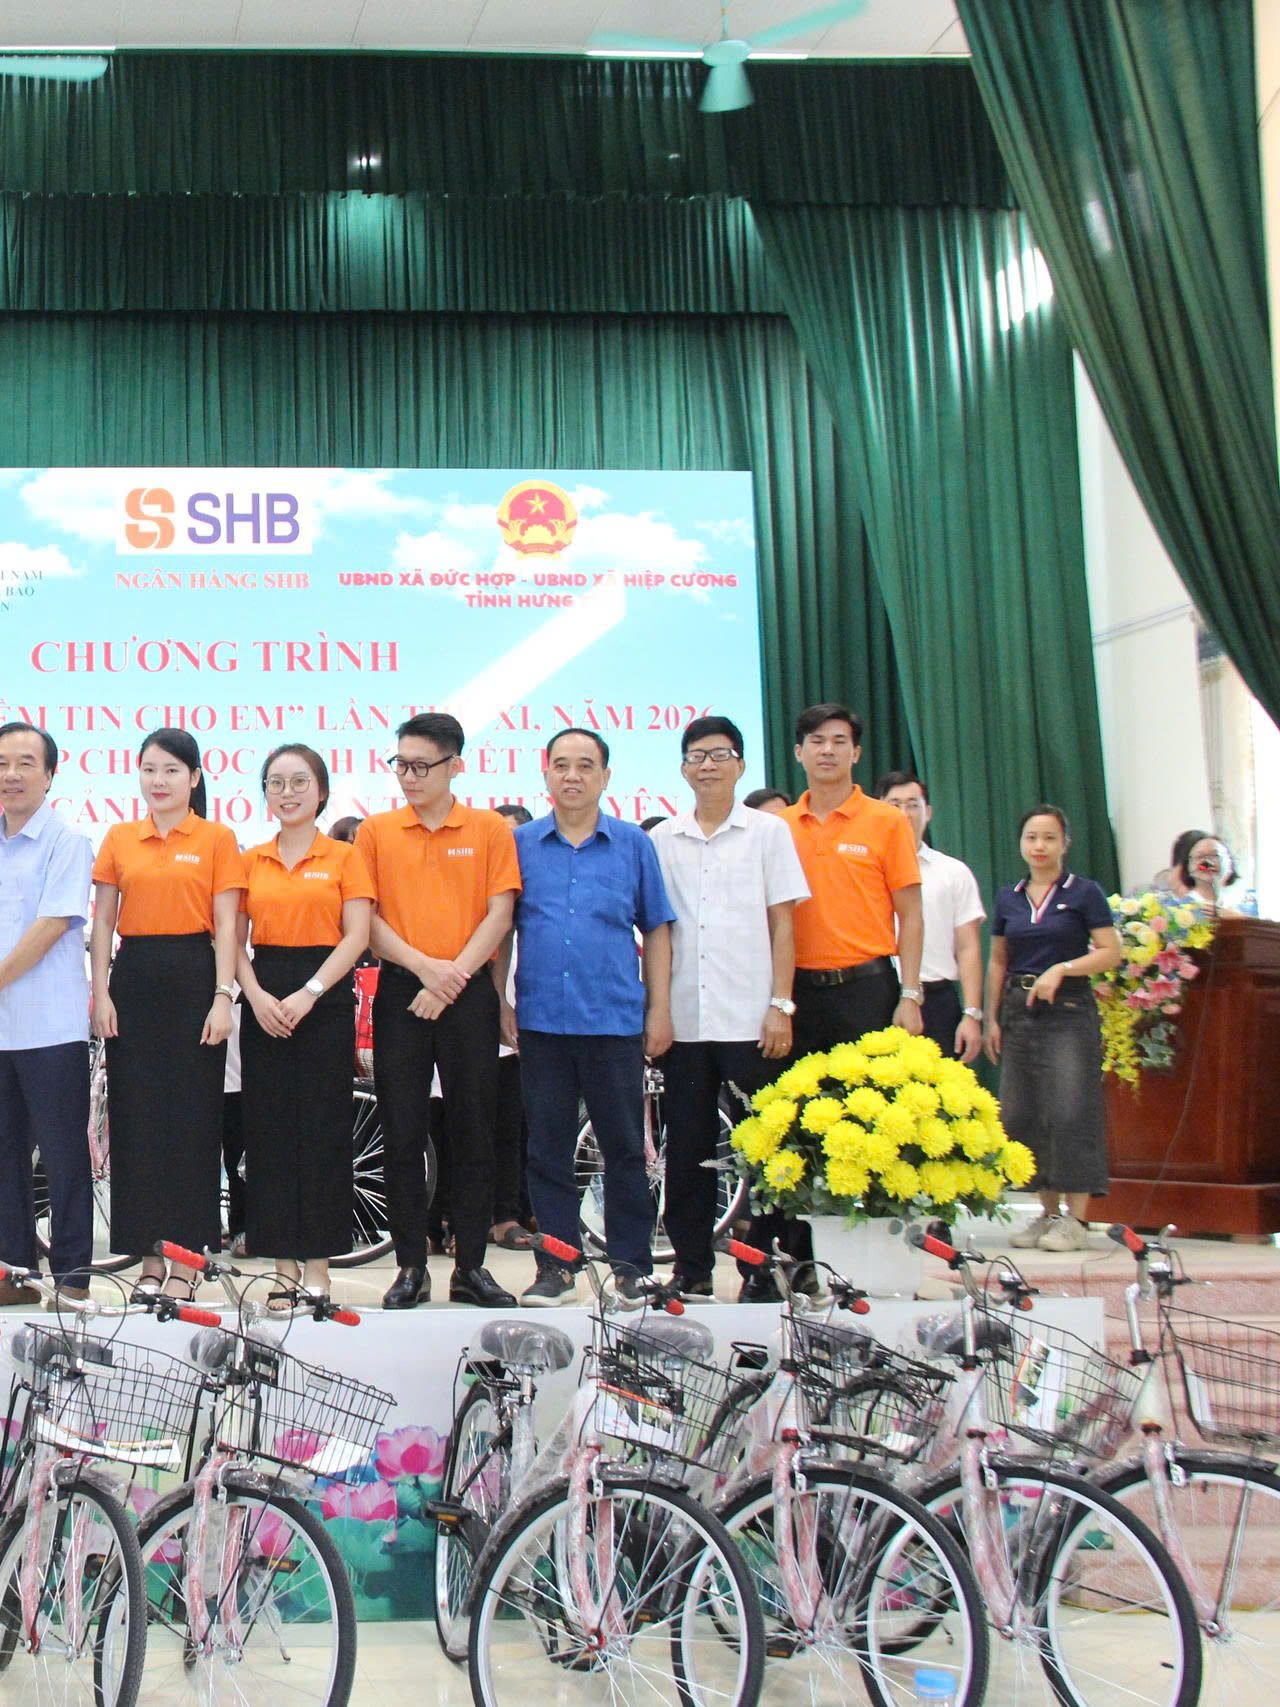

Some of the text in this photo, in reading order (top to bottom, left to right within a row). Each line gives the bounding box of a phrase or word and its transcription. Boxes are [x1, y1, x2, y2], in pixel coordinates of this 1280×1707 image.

[187, 492, 300, 545] SHB
[116, 569, 310, 589] NGÂN HÀNG SHB
[339, 573, 394, 586] UBND
[399, 568, 425, 586] XÃ
[429, 568, 470, 586] ĐỨC
[475, 573, 516, 590] HỢP
[533, 573, 587, 586] UBND
[623, 569, 665, 590] HIỆP
[670, 569, 738, 588] CƯỜNG
[464, 590, 513, 608] TỈNH
[518, 591, 574, 608] HƯNG
[31, 632, 400, 673] CHƯƠNG TRÌNH
[59, 705, 122, 731] TIN
[135, 704, 217, 732] CHO
[230, 704, 304, 731] EM”
[497, 704, 542, 732] XI,
[553, 698, 635, 731] NĂM
[79, 748, 142, 775] CH
[202, 748, 256, 781] ỌC
[607, 787, 683, 821] YÊN
